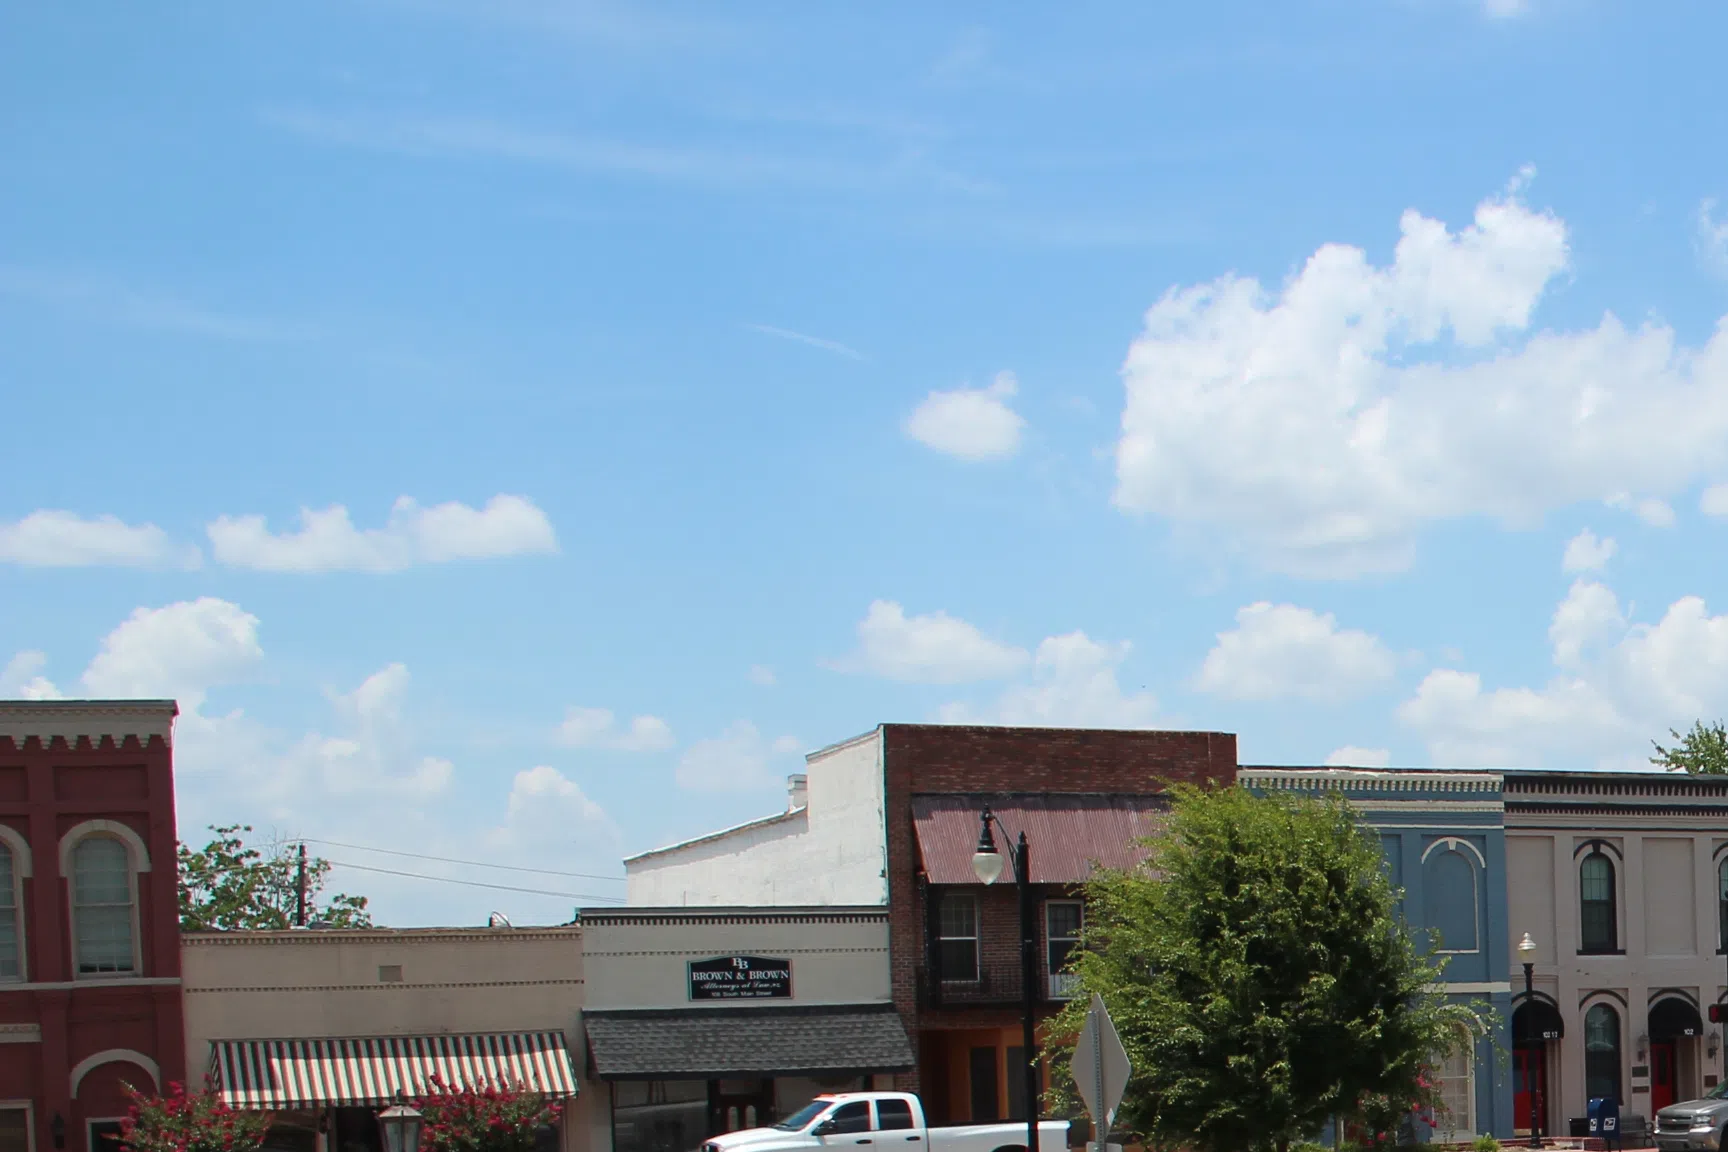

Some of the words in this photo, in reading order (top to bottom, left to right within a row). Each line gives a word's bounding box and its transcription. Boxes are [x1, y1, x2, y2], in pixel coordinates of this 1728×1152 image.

[692, 971, 733, 981] BROWN
[736, 972, 746, 980] &
[749, 969, 789, 980] BROWN
[700, 982, 740, 991] Attorneys
[741, 981, 750, 989] at
[1684, 1028, 1694, 1036] 102
